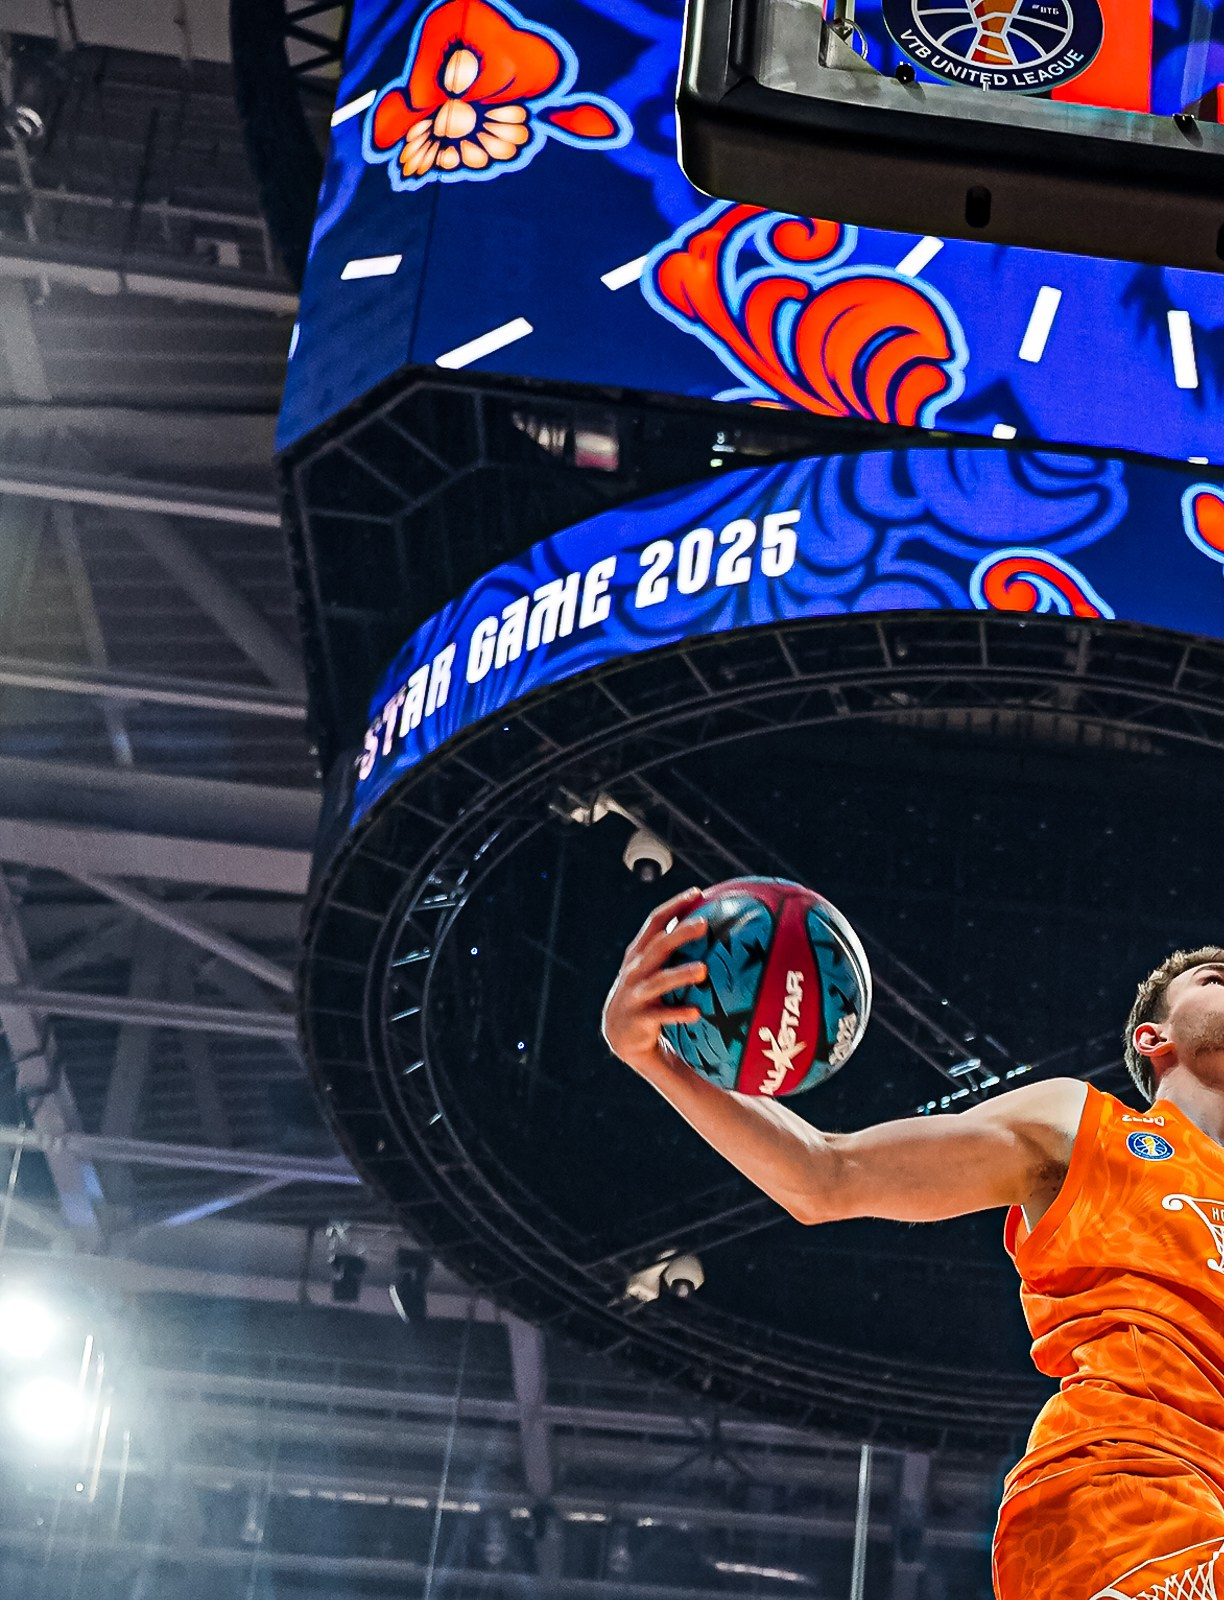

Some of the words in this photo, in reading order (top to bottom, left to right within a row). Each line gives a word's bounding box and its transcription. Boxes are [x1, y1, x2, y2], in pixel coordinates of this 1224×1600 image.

[900, 29, 932, 58] VTB
[931, 55, 1008, 86] UNITED
[1012, 49, 1084, 86] LEAGUE
[354, 642, 456, 781] STAR
[466, 555, 617, 684] GAME
[635, 509, 801, 609] 2025
[777, 970, 805, 1050] STAR
